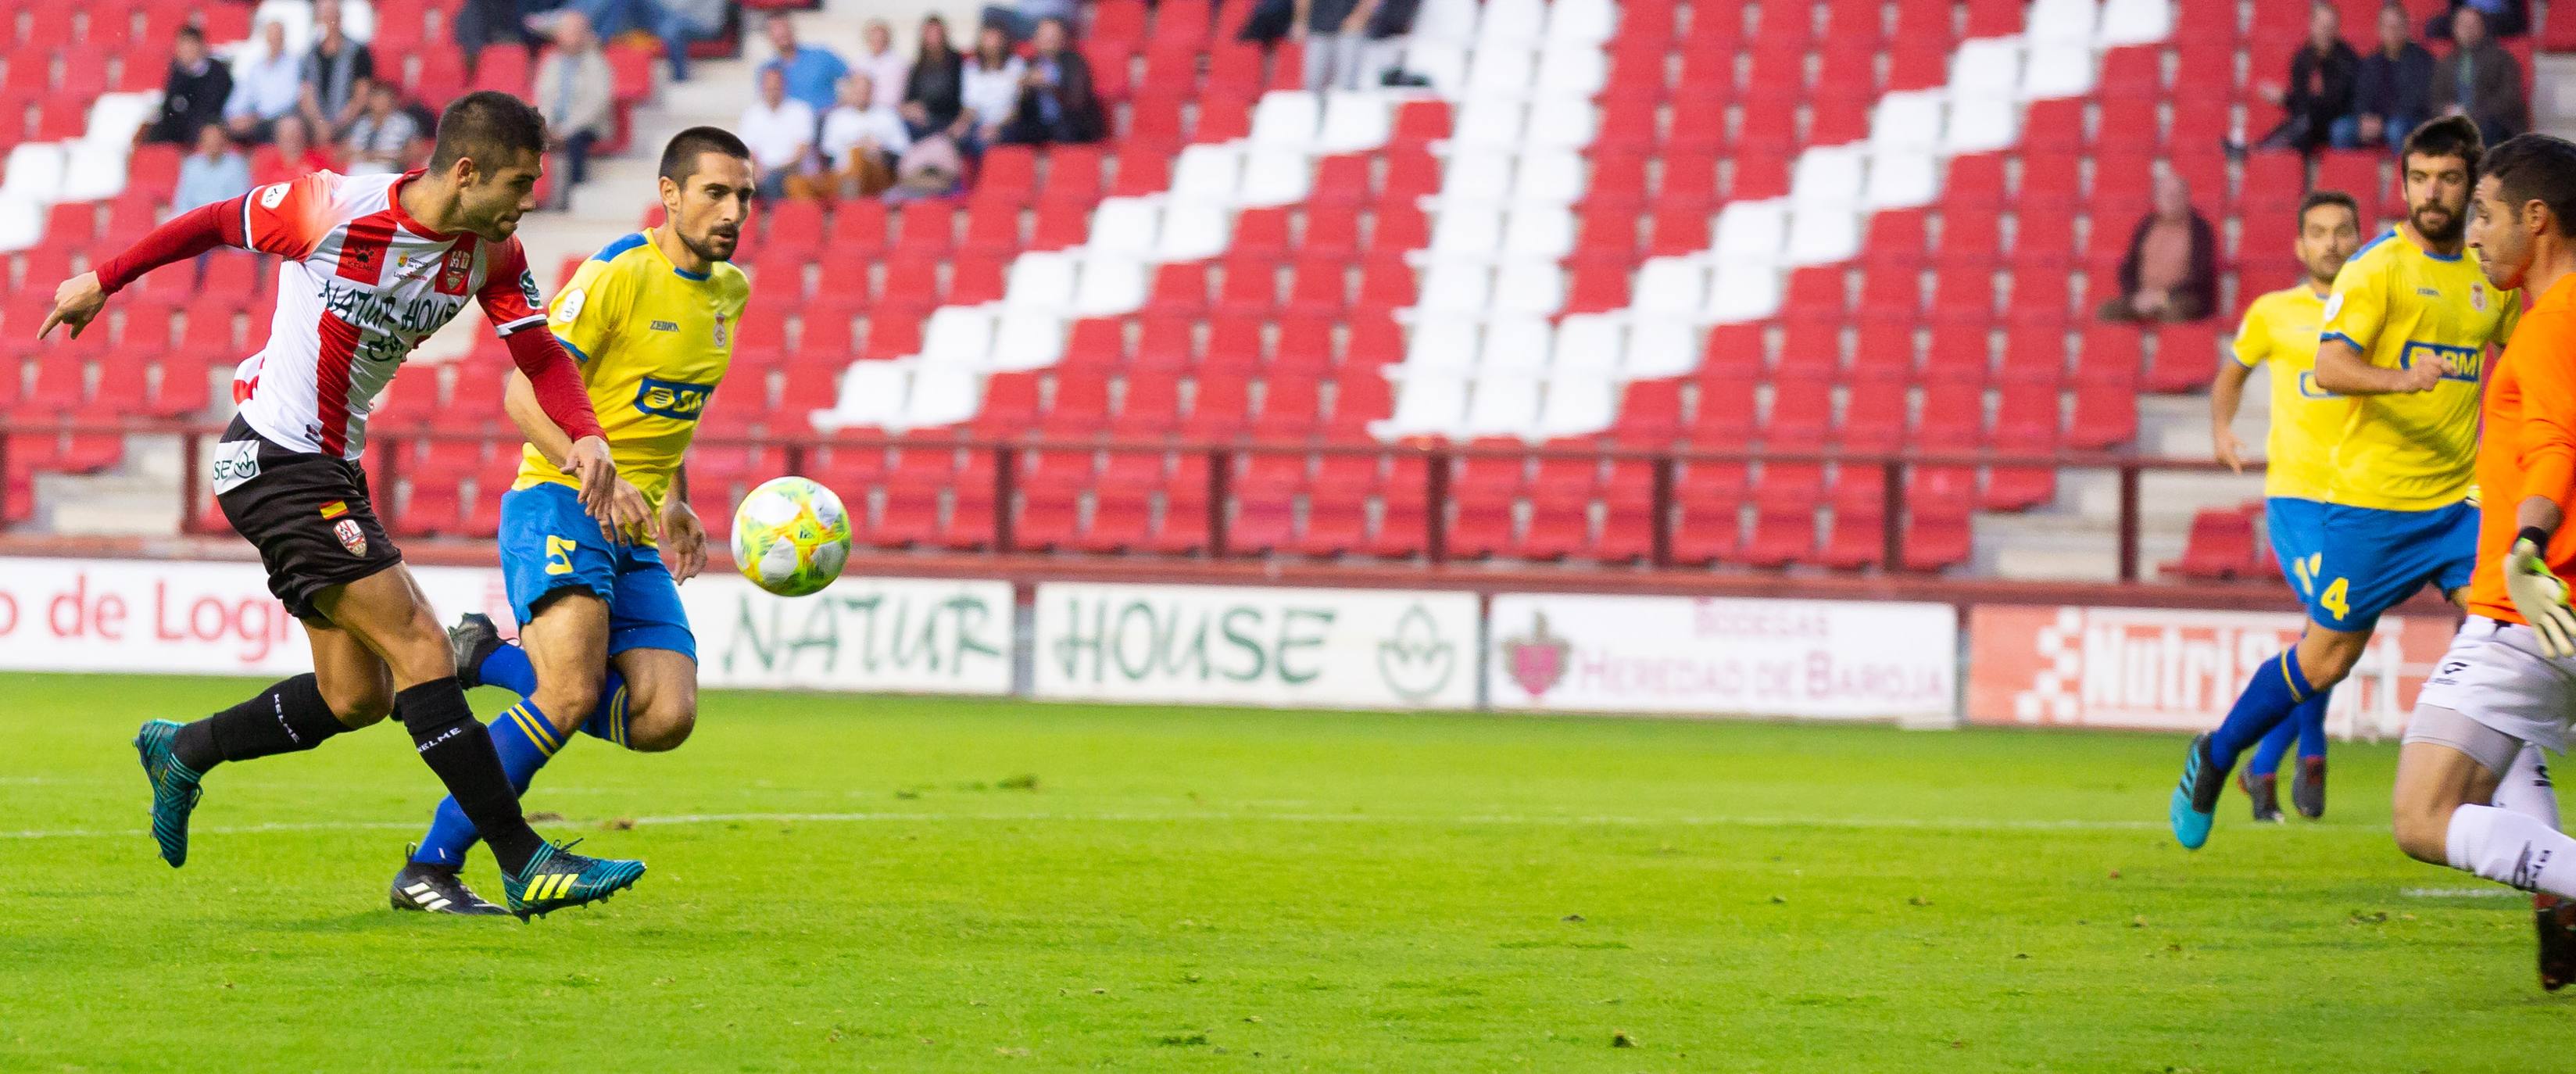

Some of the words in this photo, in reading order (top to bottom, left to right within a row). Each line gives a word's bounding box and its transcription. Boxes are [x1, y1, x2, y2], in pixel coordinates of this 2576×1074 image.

[214, 460, 232, 480] SE
[545, 534, 576, 575] 5
[49, 572, 126, 640] de
[2320, 576, 2350, 621] 4
[722, 591, 1003, 675] NATUR
[1052, 599, 1336, 684] HOUSE
[274, 693, 300, 743] KELME
